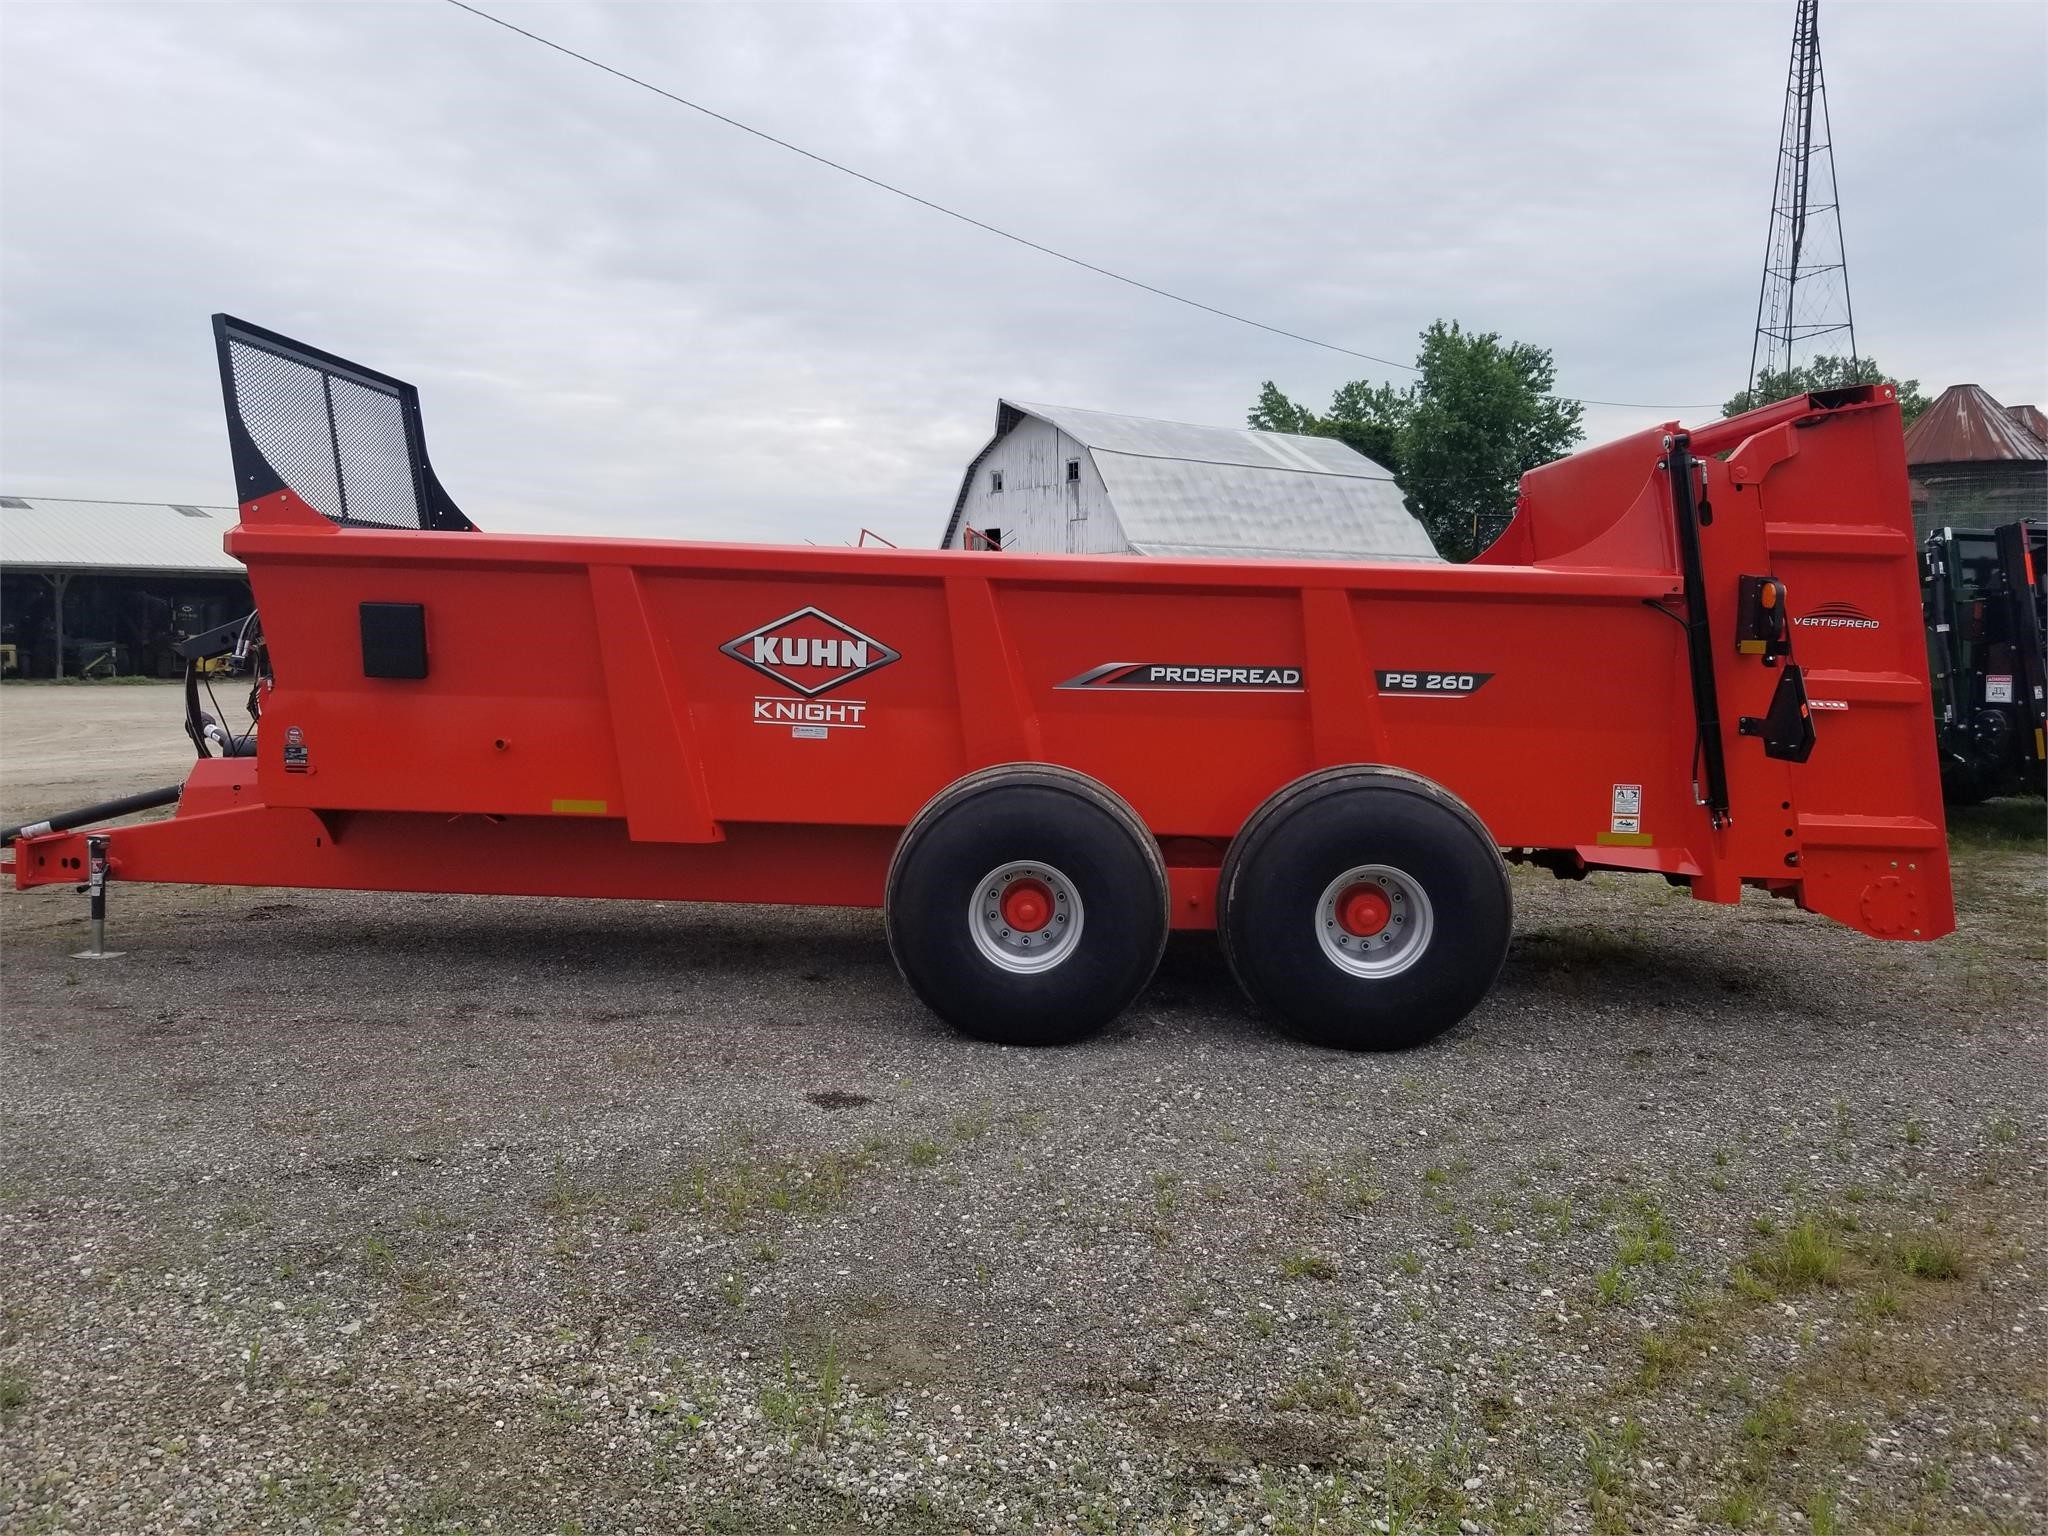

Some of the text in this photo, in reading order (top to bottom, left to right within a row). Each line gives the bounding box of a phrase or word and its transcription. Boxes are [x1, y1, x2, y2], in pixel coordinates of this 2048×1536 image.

[1793, 617, 1880, 629] VERTISPREAD
[754, 636, 867, 668] KUHN
[1150, 667, 1300, 684] PROSPREAD
[1385, 673, 1474, 690] PS 260
[754, 702, 866, 722] KNIGHT
